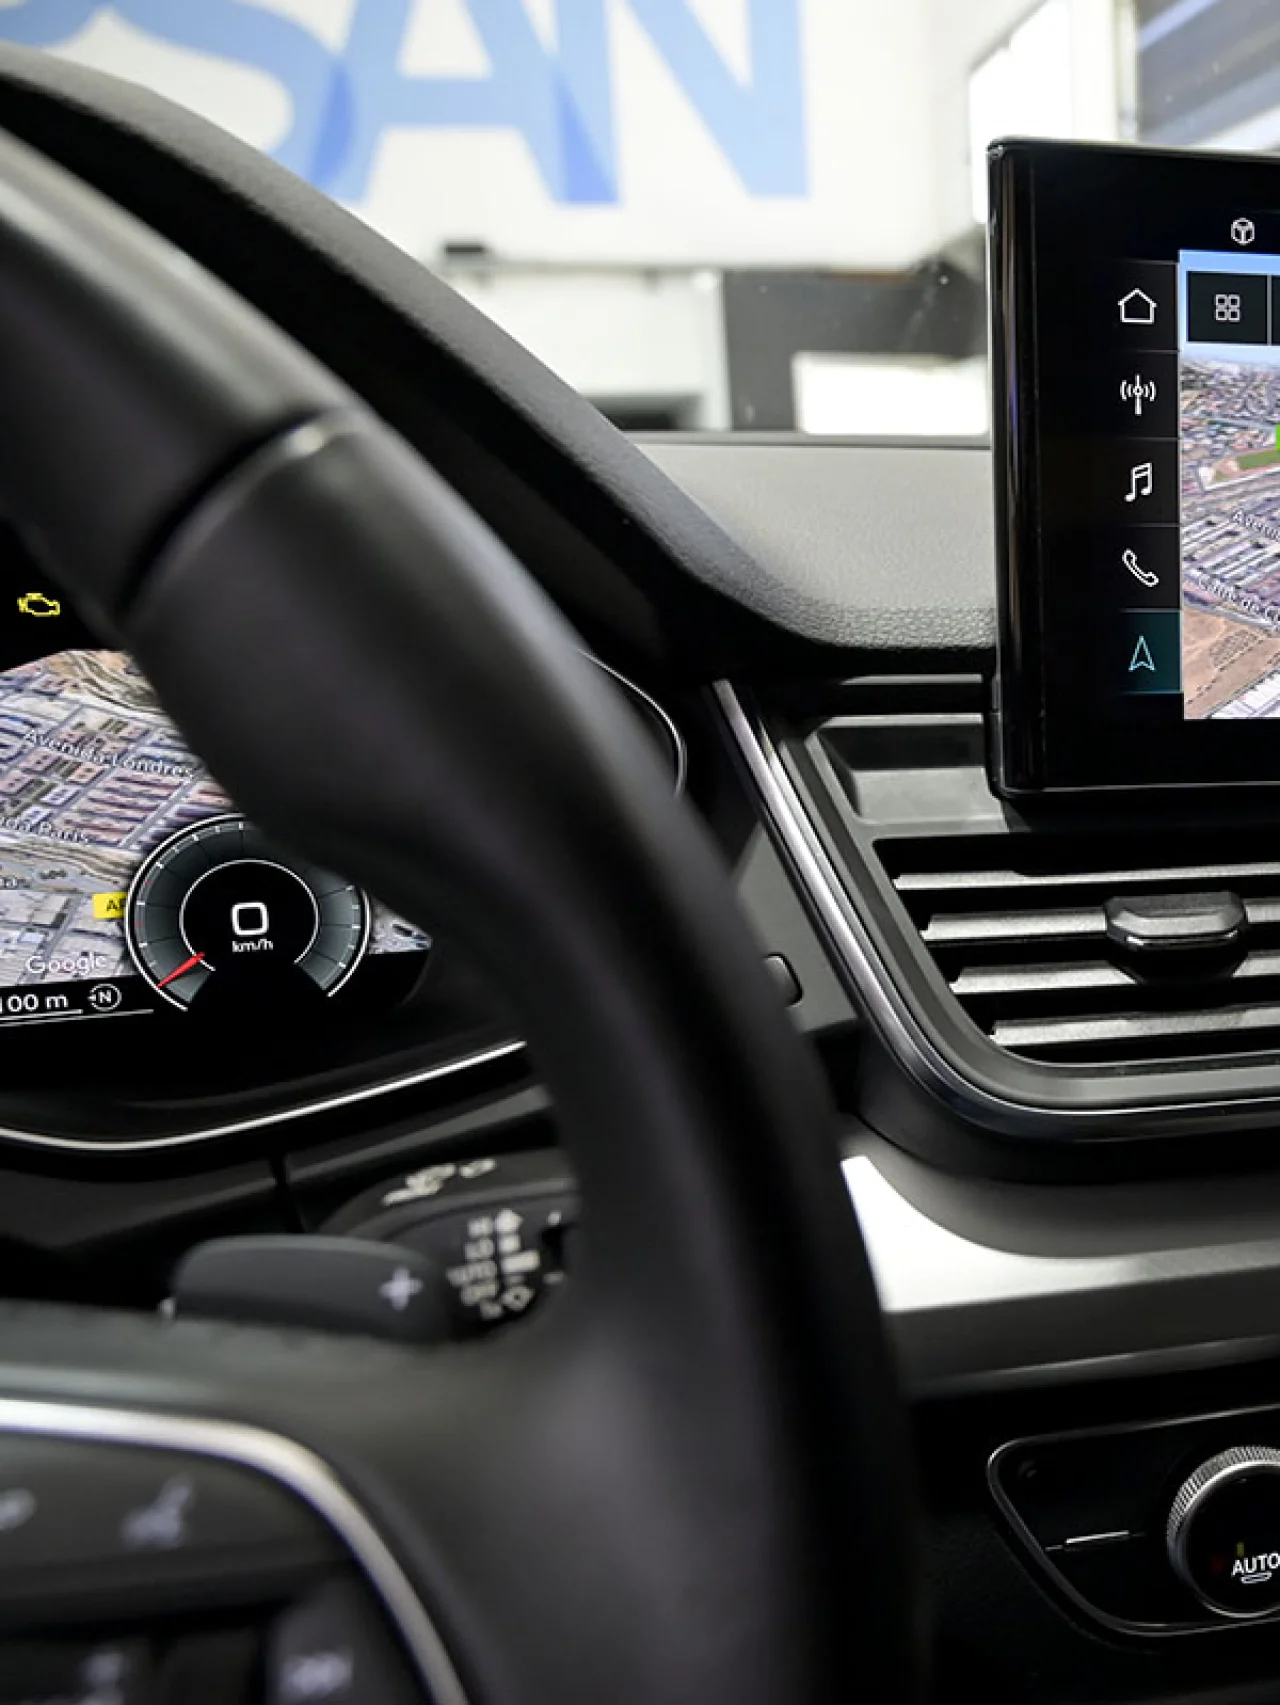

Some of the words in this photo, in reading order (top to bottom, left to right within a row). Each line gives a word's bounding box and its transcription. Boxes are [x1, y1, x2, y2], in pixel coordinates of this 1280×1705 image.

[0, 0, 812, 207] SAN
[231, 901, 269, 936] 0
[232, 938, 274, 953] km/h
[26, 952, 107, 975] Google
[46, 994, 69, 1010] m
[97, 989, 112, 1004] N
[1231, 1552, 1280, 1577] AUTO
